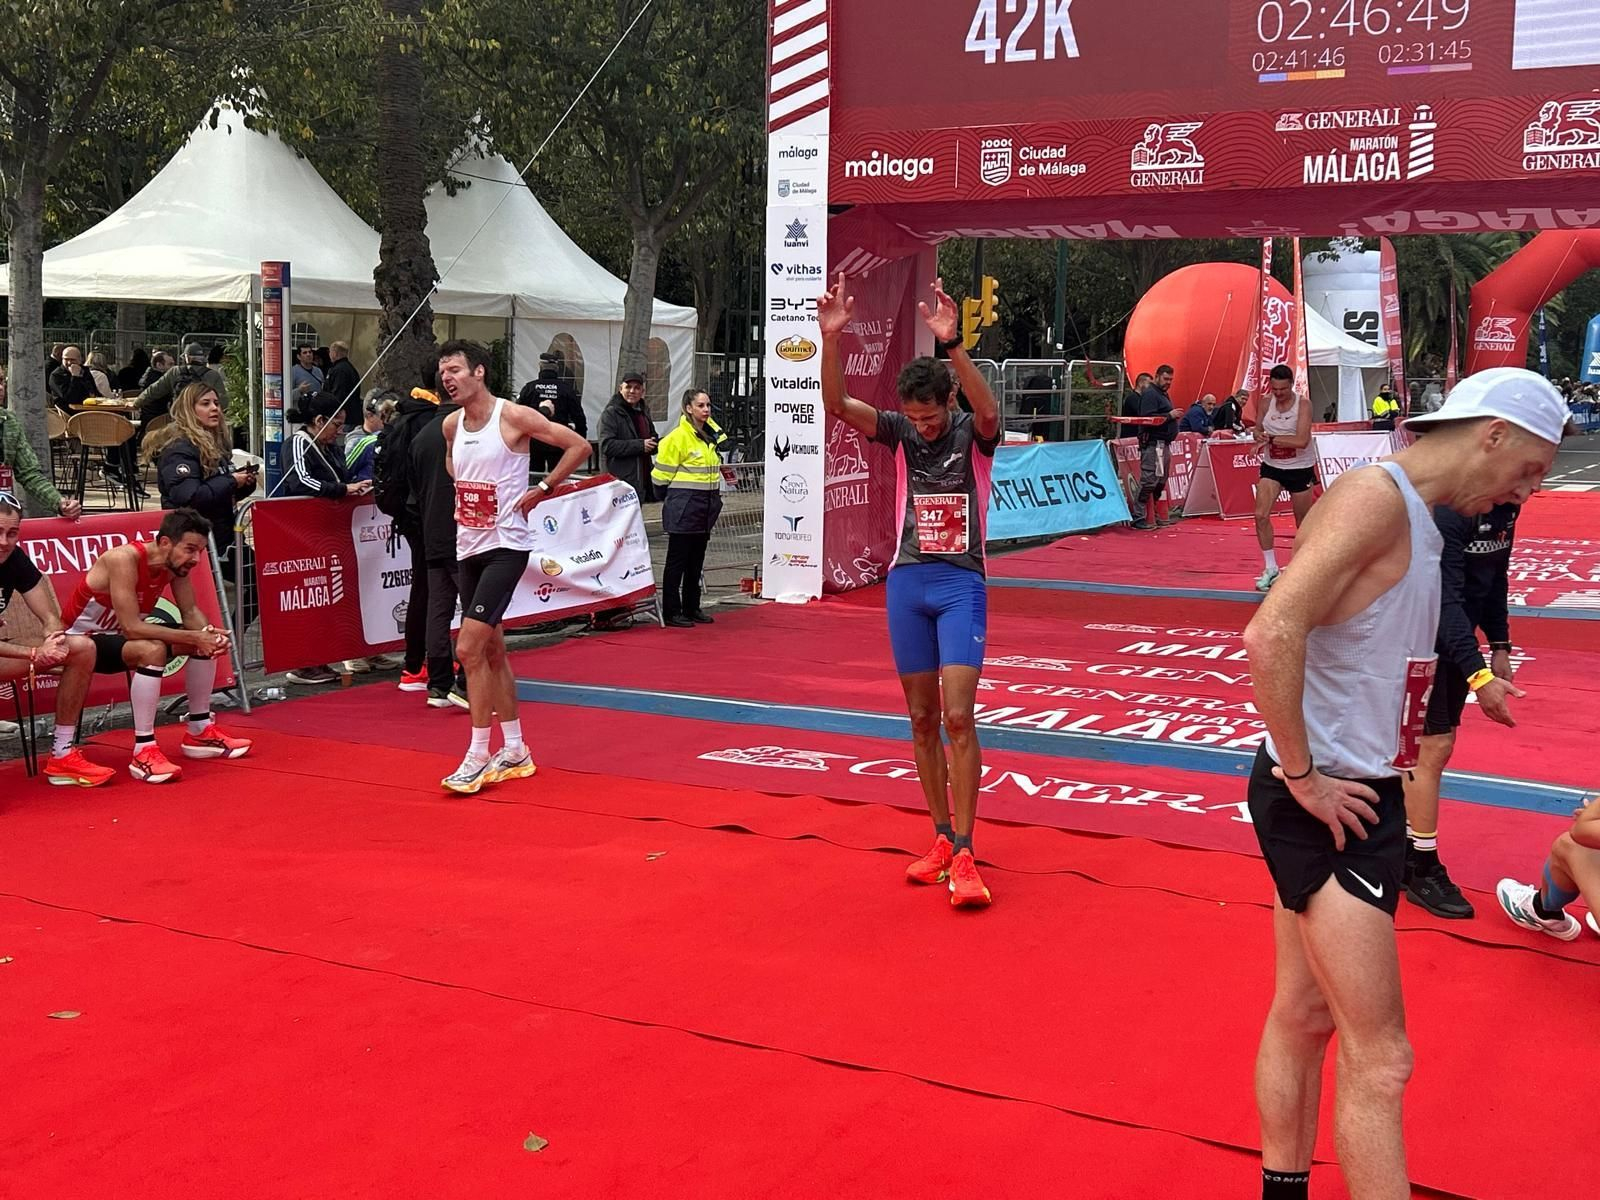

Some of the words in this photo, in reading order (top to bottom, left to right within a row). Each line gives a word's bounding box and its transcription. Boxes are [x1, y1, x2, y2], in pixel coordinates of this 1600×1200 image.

[1257, 0, 1470, 43] 02:46:49
[964, 0, 1080, 64] 42K
[1252, 46, 1345, 72] 02:41:46
[1378, 39, 1472, 64] 02:31:45
[1305, 107, 1401, 130] GENERALI
[1350, 134, 1399, 152] MARATÓN
[778, 145, 819, 160] málaga
[1018, 144, 1067, 160] Ciudad
[845, 150, 934, 182] málaga
[1018, 164, 1036, 176] de
[1038, 162, 1087, 177] Málaga
[1303, 148, 1401, 184] MÁLAGA
[1130, 169, 1205, 187] GENERALI
[784, 240, 809, 248] luanvi
[786, 263, 822, 275] vithas
[771, 314, 805, 322] Caetano
[1473, 341, 1515, 352] GENERALI
[771, 376, 820, 390] Vitaldin
[774, 402, 815, 414] POWER
[792, 413, 815, 424] ADE
[464, 493, 479, 502] 508
[920, 496, 957, 506] GENERALI
[920, 509, 944, 521] 347
[279, 556, 327, 574] GENERALI
[280, 585, 331, 612] MÁLAGA
